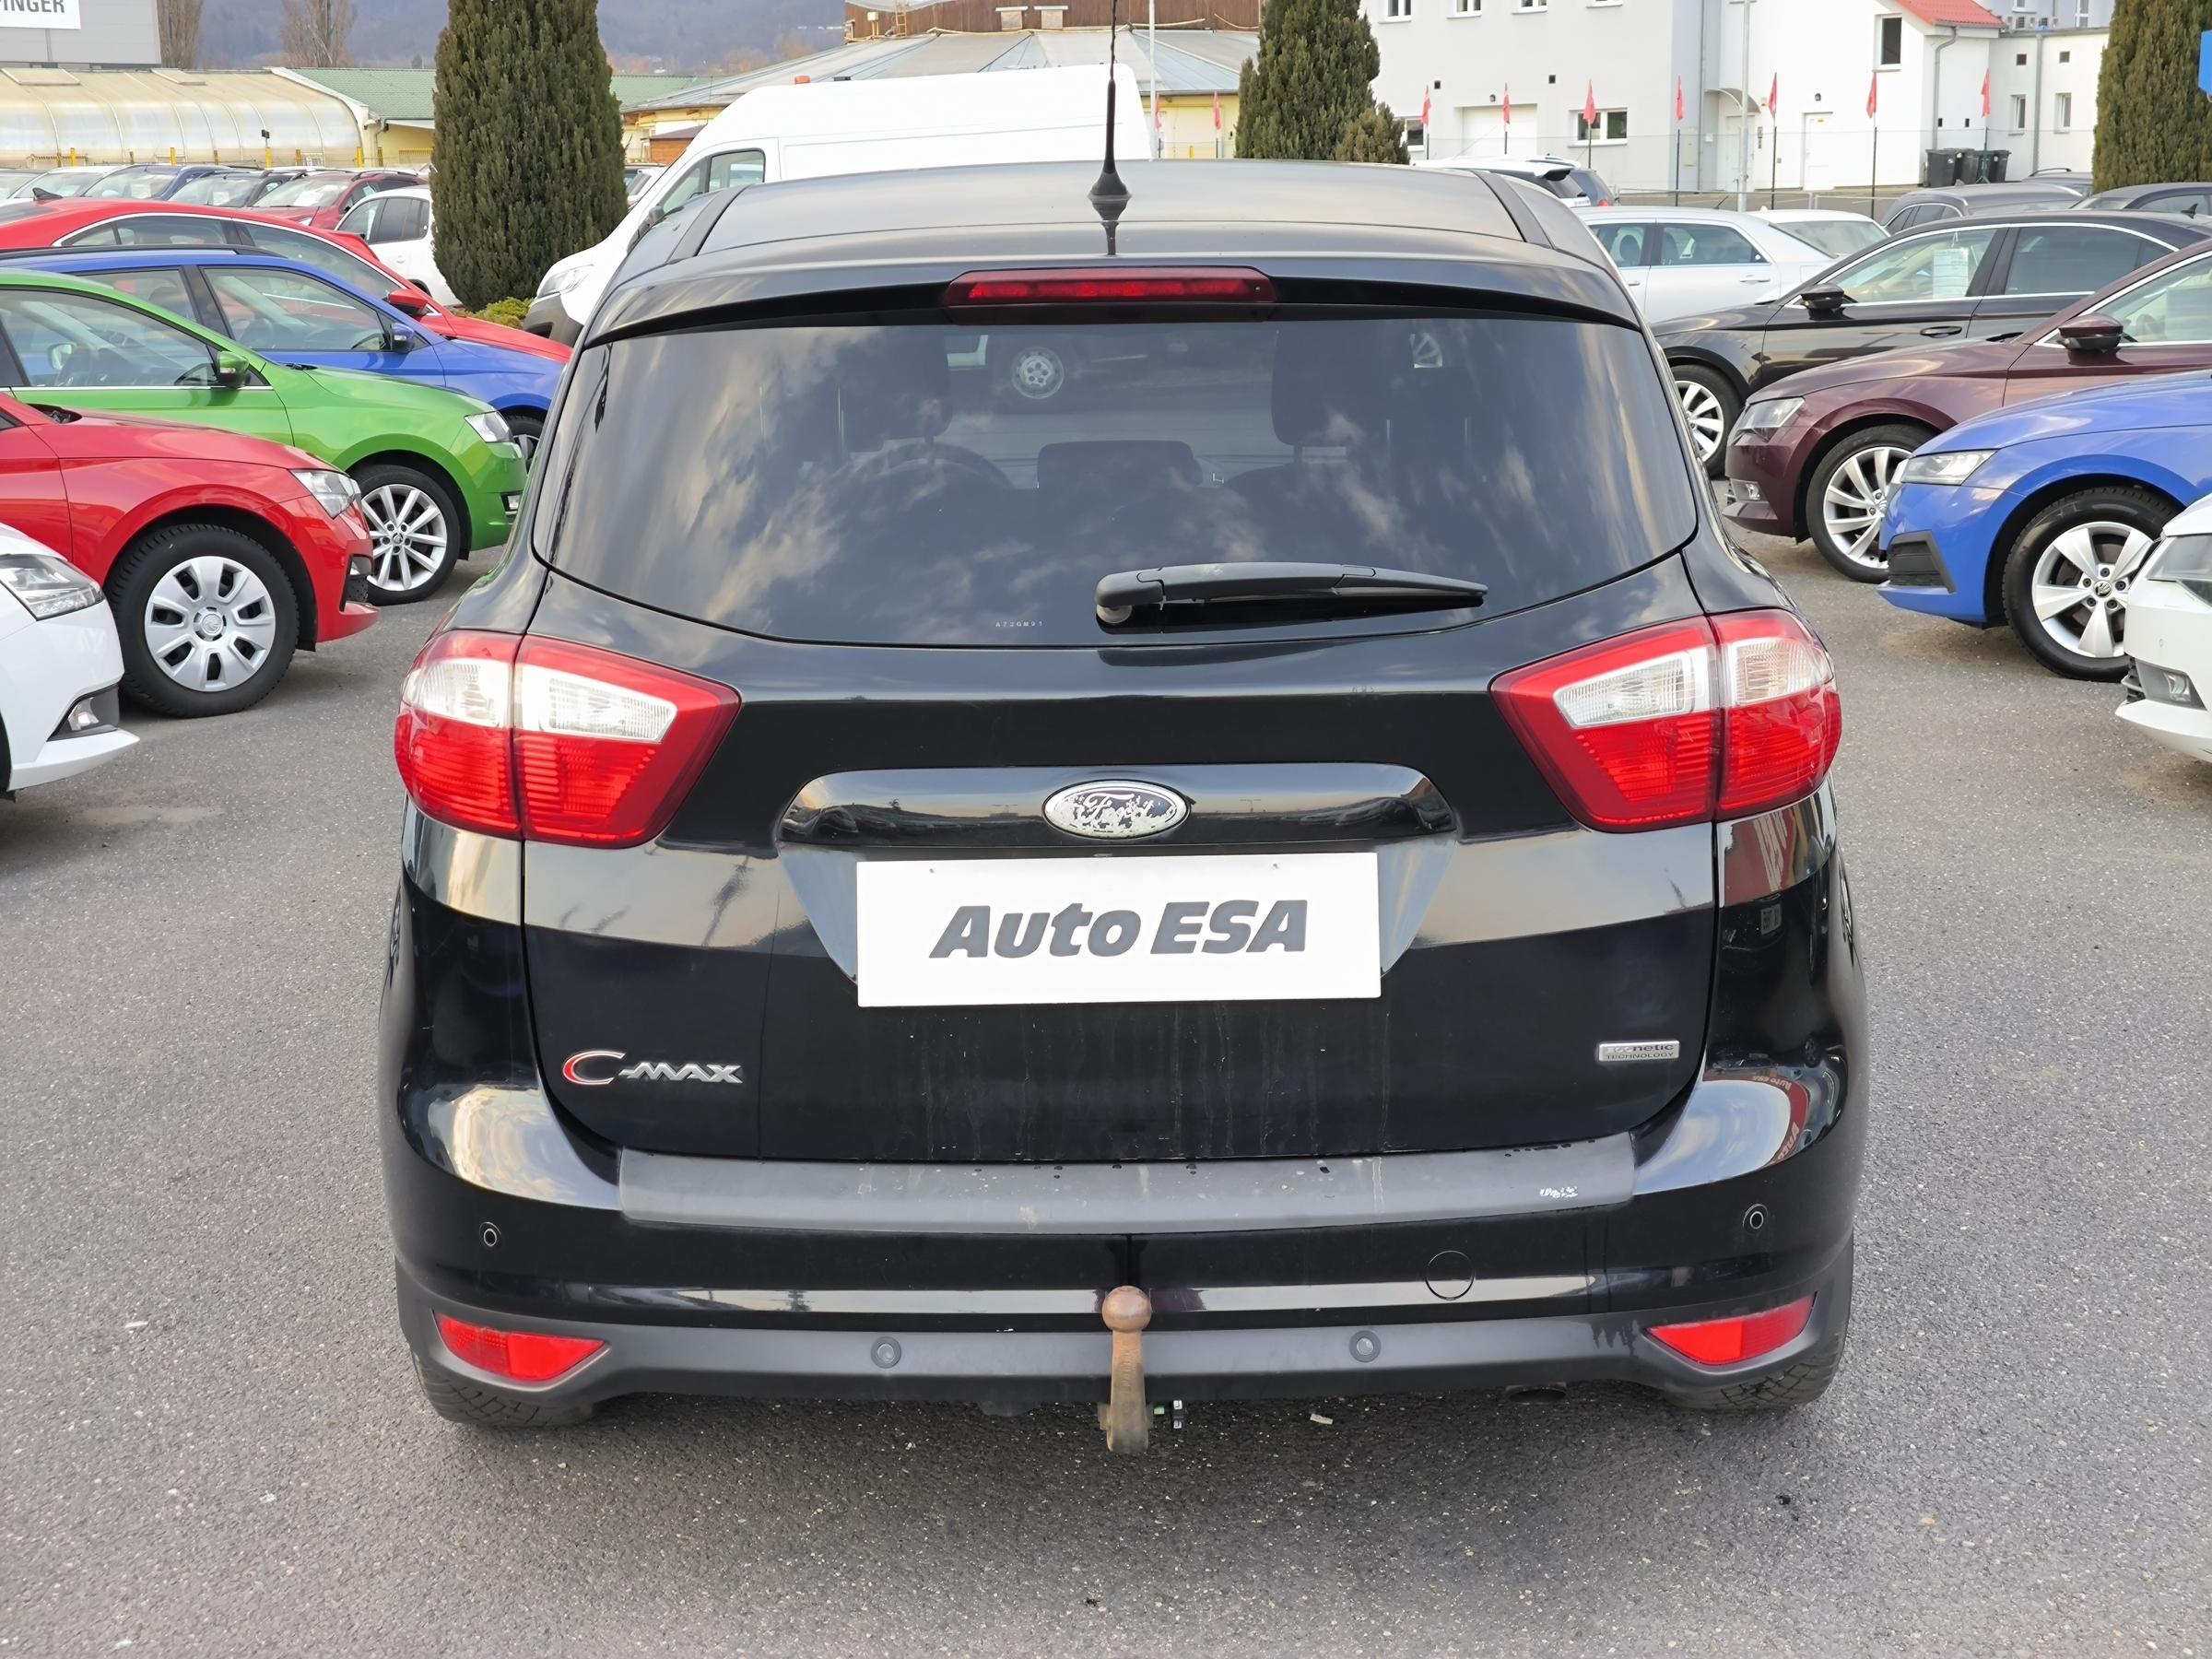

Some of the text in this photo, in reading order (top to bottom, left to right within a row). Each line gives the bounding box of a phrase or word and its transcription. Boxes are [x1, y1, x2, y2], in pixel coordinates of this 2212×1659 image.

[0, 0, 65, 13] INGER
[928, 900, 1308, 959] Auto ESA
[1606, 1052, 1674, 1060] TECHNOLOGY
[562, 1051, 744, 1085] C-MAX
